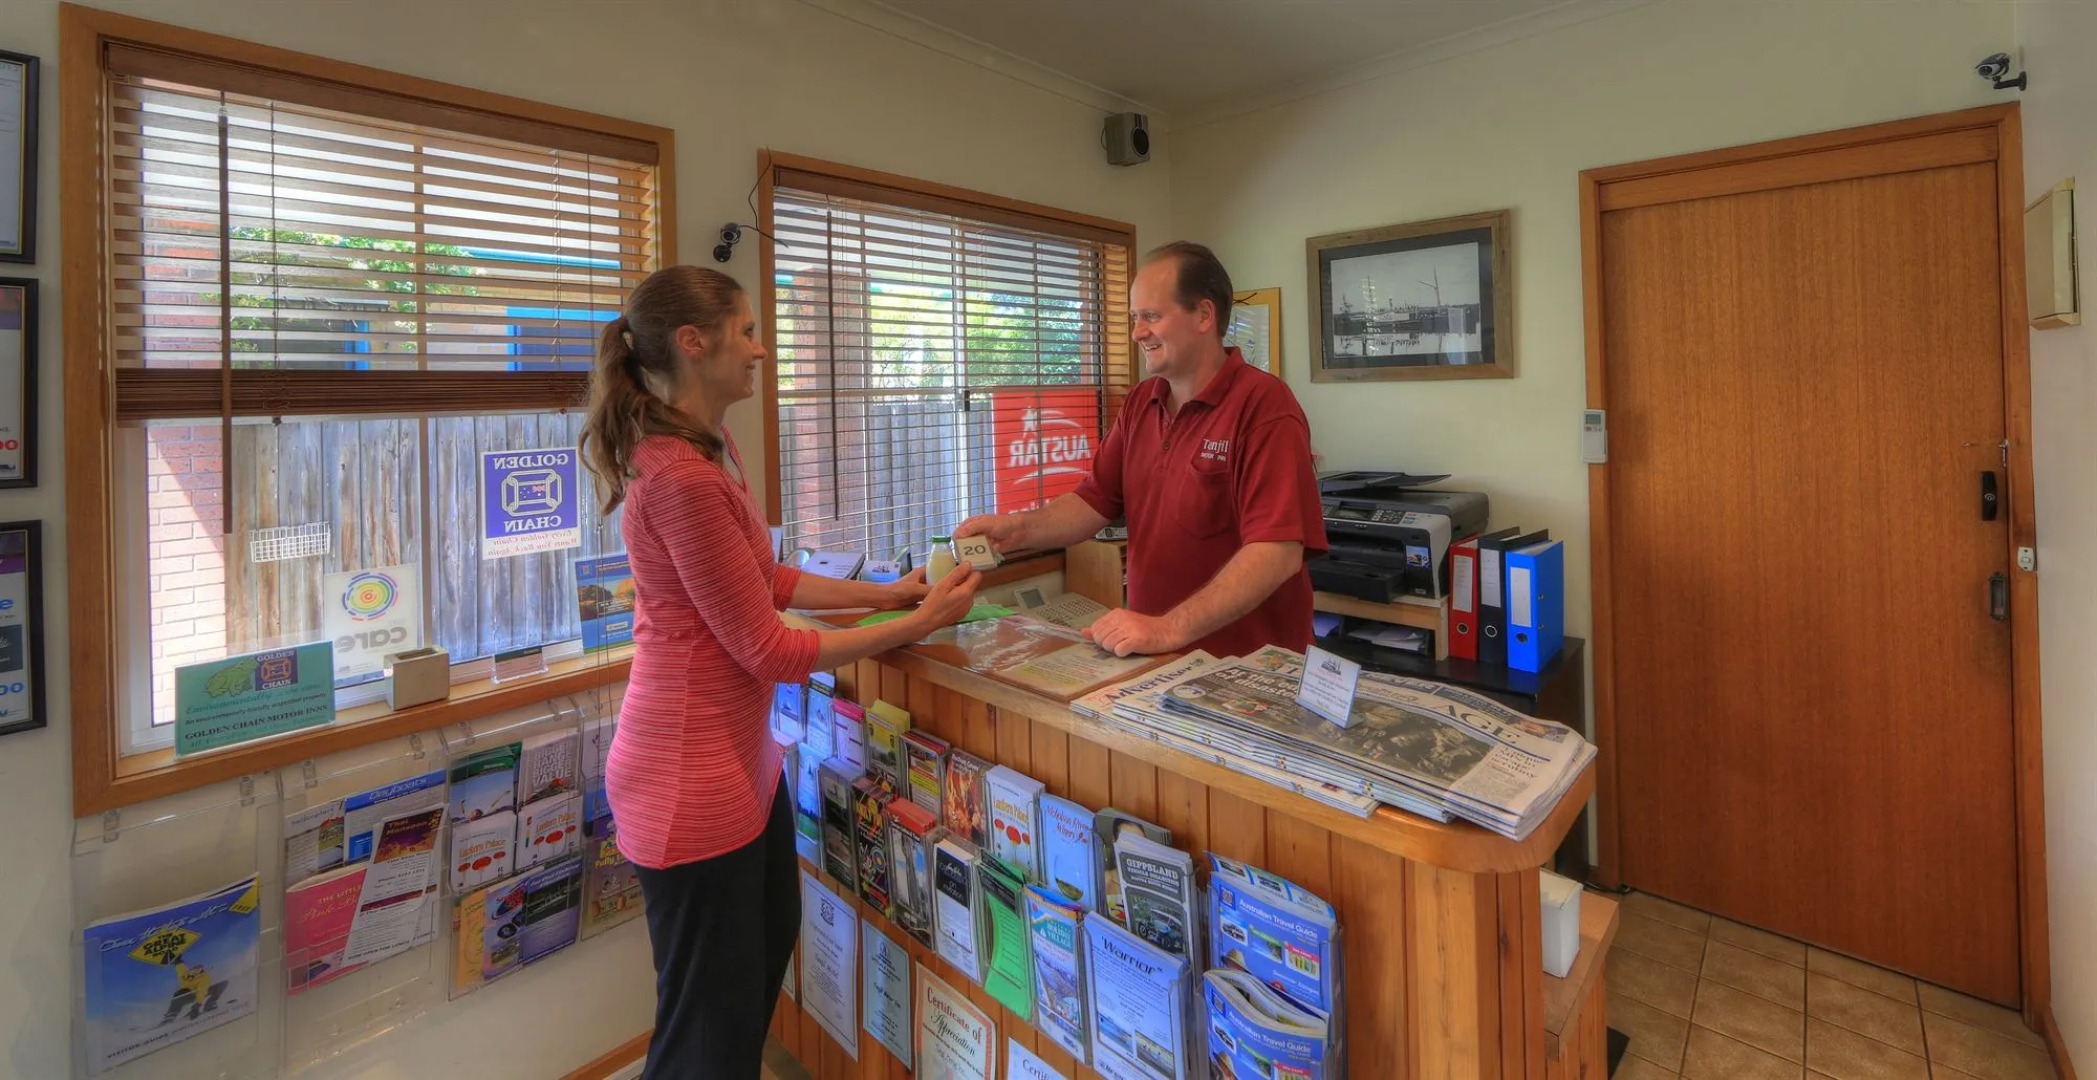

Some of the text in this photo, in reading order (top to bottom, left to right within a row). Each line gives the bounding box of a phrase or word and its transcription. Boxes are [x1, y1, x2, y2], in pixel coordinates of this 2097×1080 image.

[1203, 438, 1229, 453] Tanjil
[963, 544, 986, 556] 20
[256, 650, 295, 662] GOLDEN
[262, 679, 292, 690] CHAIN
[1105, 664, 1193, 704] Advertiser
[1248, 674, 1275, 685] the
[184, 703, 328, 741] GOLDEN CHAIN MOTOR INNS
[1431, 704, 1521, 745] AGE
[1126, 858, 1179, 880] GIPPSLAND
[1239, 899, 1318, 939] Australian Travel Guide
[143, 932, 187, 951] GREAT
[143, 939, 188, 956] ALPINE
[927, 986, 982, 1045] Certificate of
[930, 1010, 976, 1057] Appreciation
[1228, 1010, 1311, 1053] Australian Travel Guide
